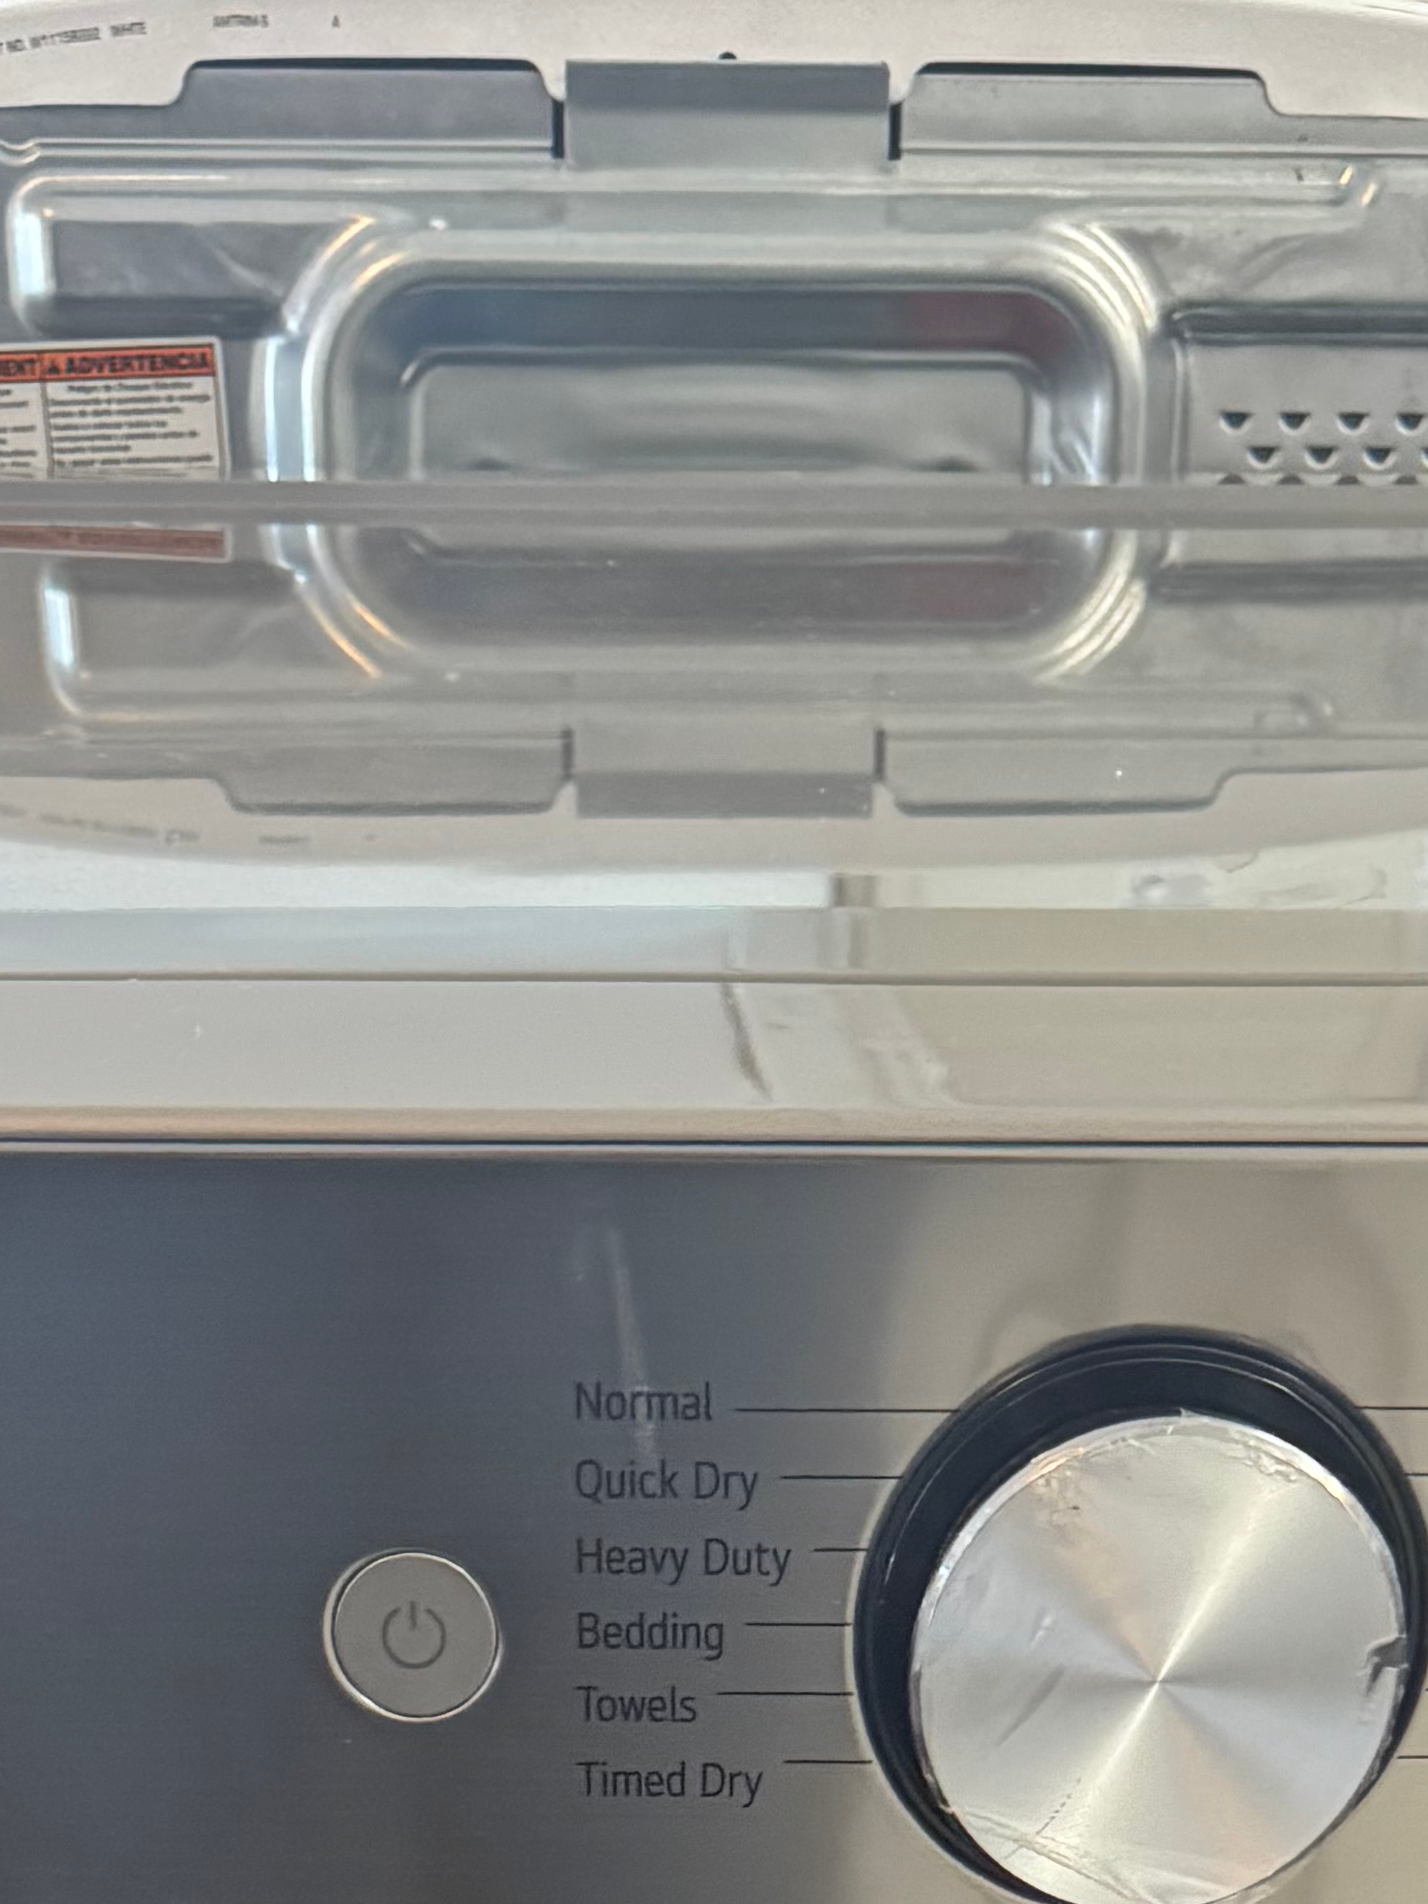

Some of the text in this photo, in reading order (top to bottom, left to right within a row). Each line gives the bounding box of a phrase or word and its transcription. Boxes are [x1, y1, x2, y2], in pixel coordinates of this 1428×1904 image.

[63, 351, 209, 375] ADVERTENCIA
[575, 1382, 712, 1421] Normal
[575, 1459, 758, 1511] Quick Dry
[575, 1537, 791, 1586] Heavy Duty
[577, 1612, 724, 1661] Bedding
[575, 1685, 697, 1724] Towels
[575, 1761, 762, 1808] Timed Dry
